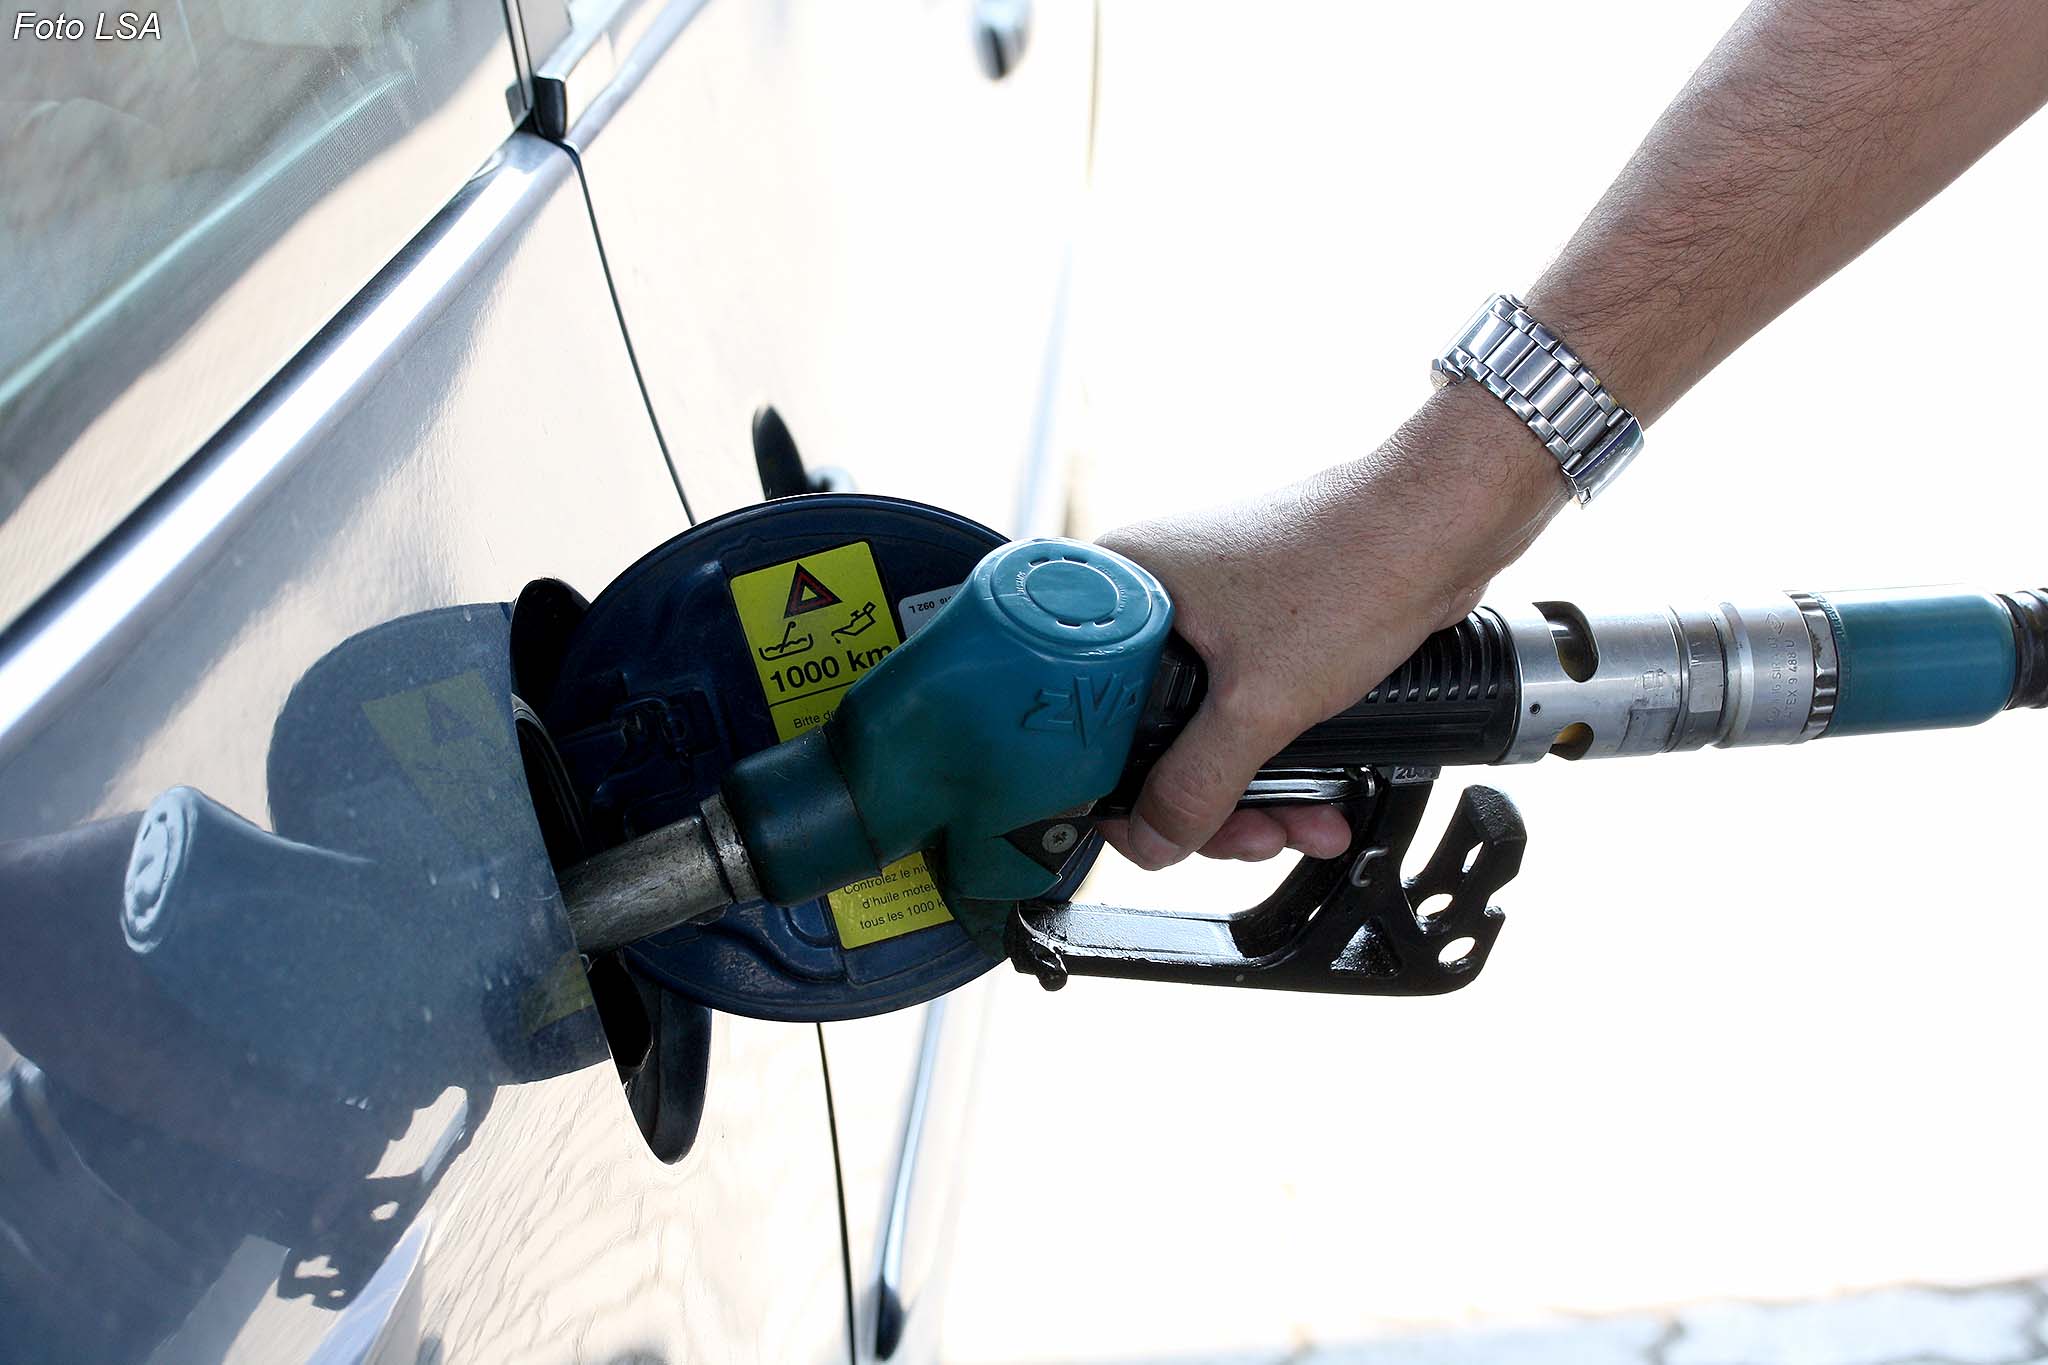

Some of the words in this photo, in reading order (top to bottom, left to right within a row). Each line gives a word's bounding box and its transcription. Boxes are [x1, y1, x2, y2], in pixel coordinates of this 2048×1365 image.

[769, 656, 840, 693] 1000
[846, 645, 894, 672] km
[793, 714, 821, 729] Bitte
[899, 869, 911, 879] le
[862, 892, 900, 909] d'huile
[860, 917, 885, 930] tous
[887, 911, 905, 922] les
[907, 901, 935, 916] 1000
